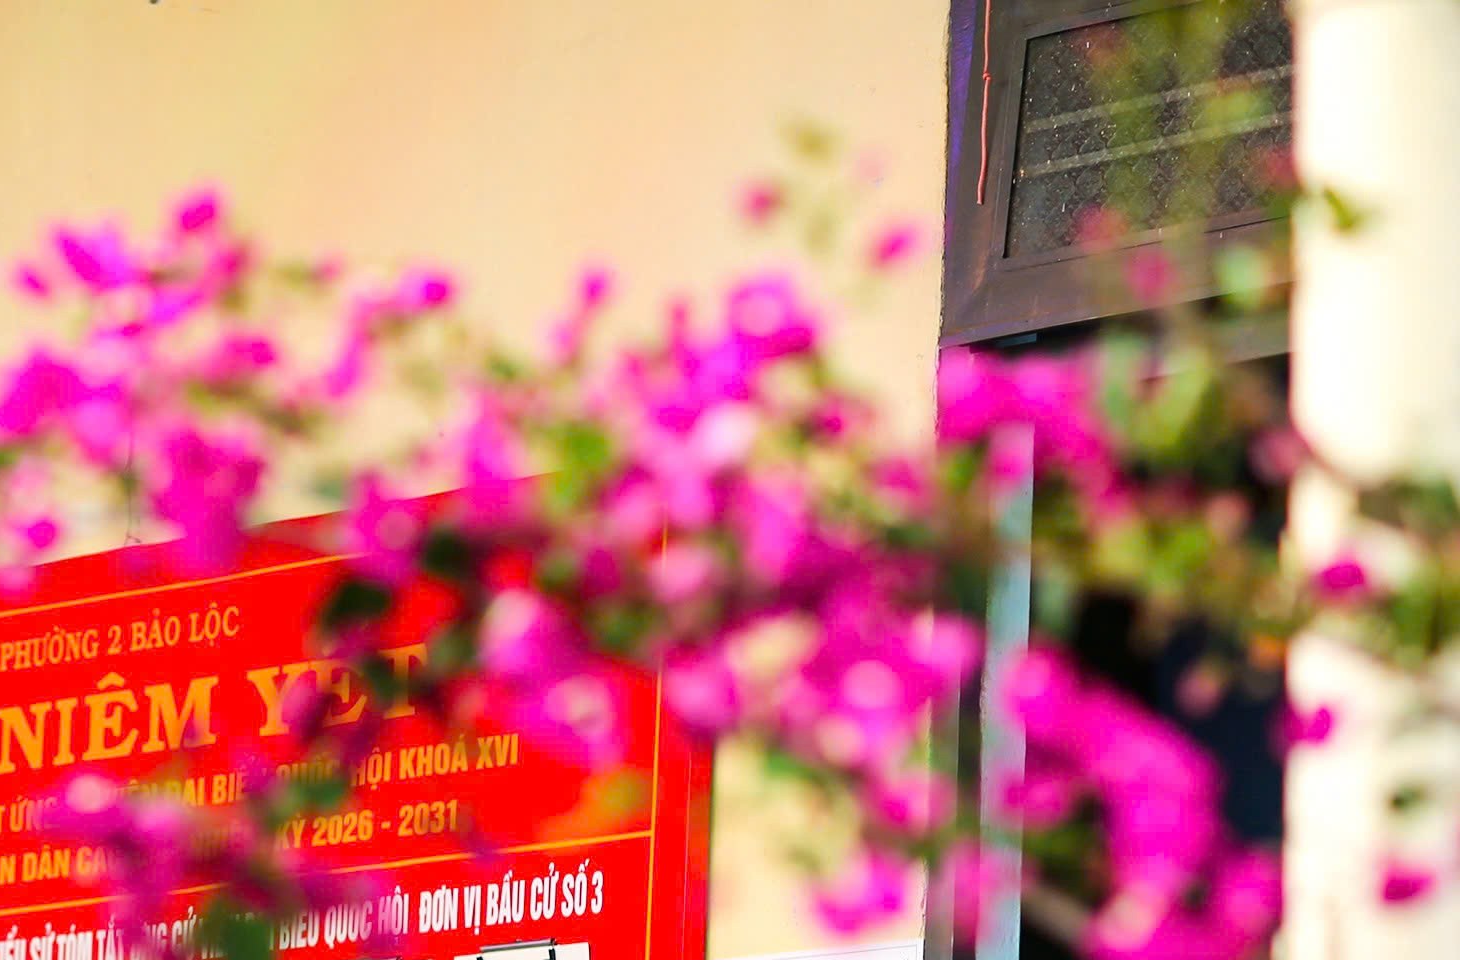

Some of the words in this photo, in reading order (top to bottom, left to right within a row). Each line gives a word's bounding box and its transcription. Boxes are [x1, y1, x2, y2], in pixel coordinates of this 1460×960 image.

[0, 625, 99, 672] PHƯỜNG
[107, 625, 122, 655] 2
[130, 608, 180, 652] BẢO
[189, 601, 239, 647] LỘC
[350, 747, 392, 790] HỘI
[399, 734, 468, 780] KHOÁ
[476, 734, 519, 770] XVI
[22, 845, 71, 881] DÂN
[311, 809, 373, 848] 2026
[397, 799, 458, 837] 2031
[378, 886, 409, 940] HỘI
[419, 884, 459, 933] ĐƠN
[464, 885, 481, 935] VỊ
[486, 870, 526, 926] BẦU
[530, 862, 560, 920] CỬ
[561, 858, 590, 917] SỐ
[591, 870, 604, 914] 3
